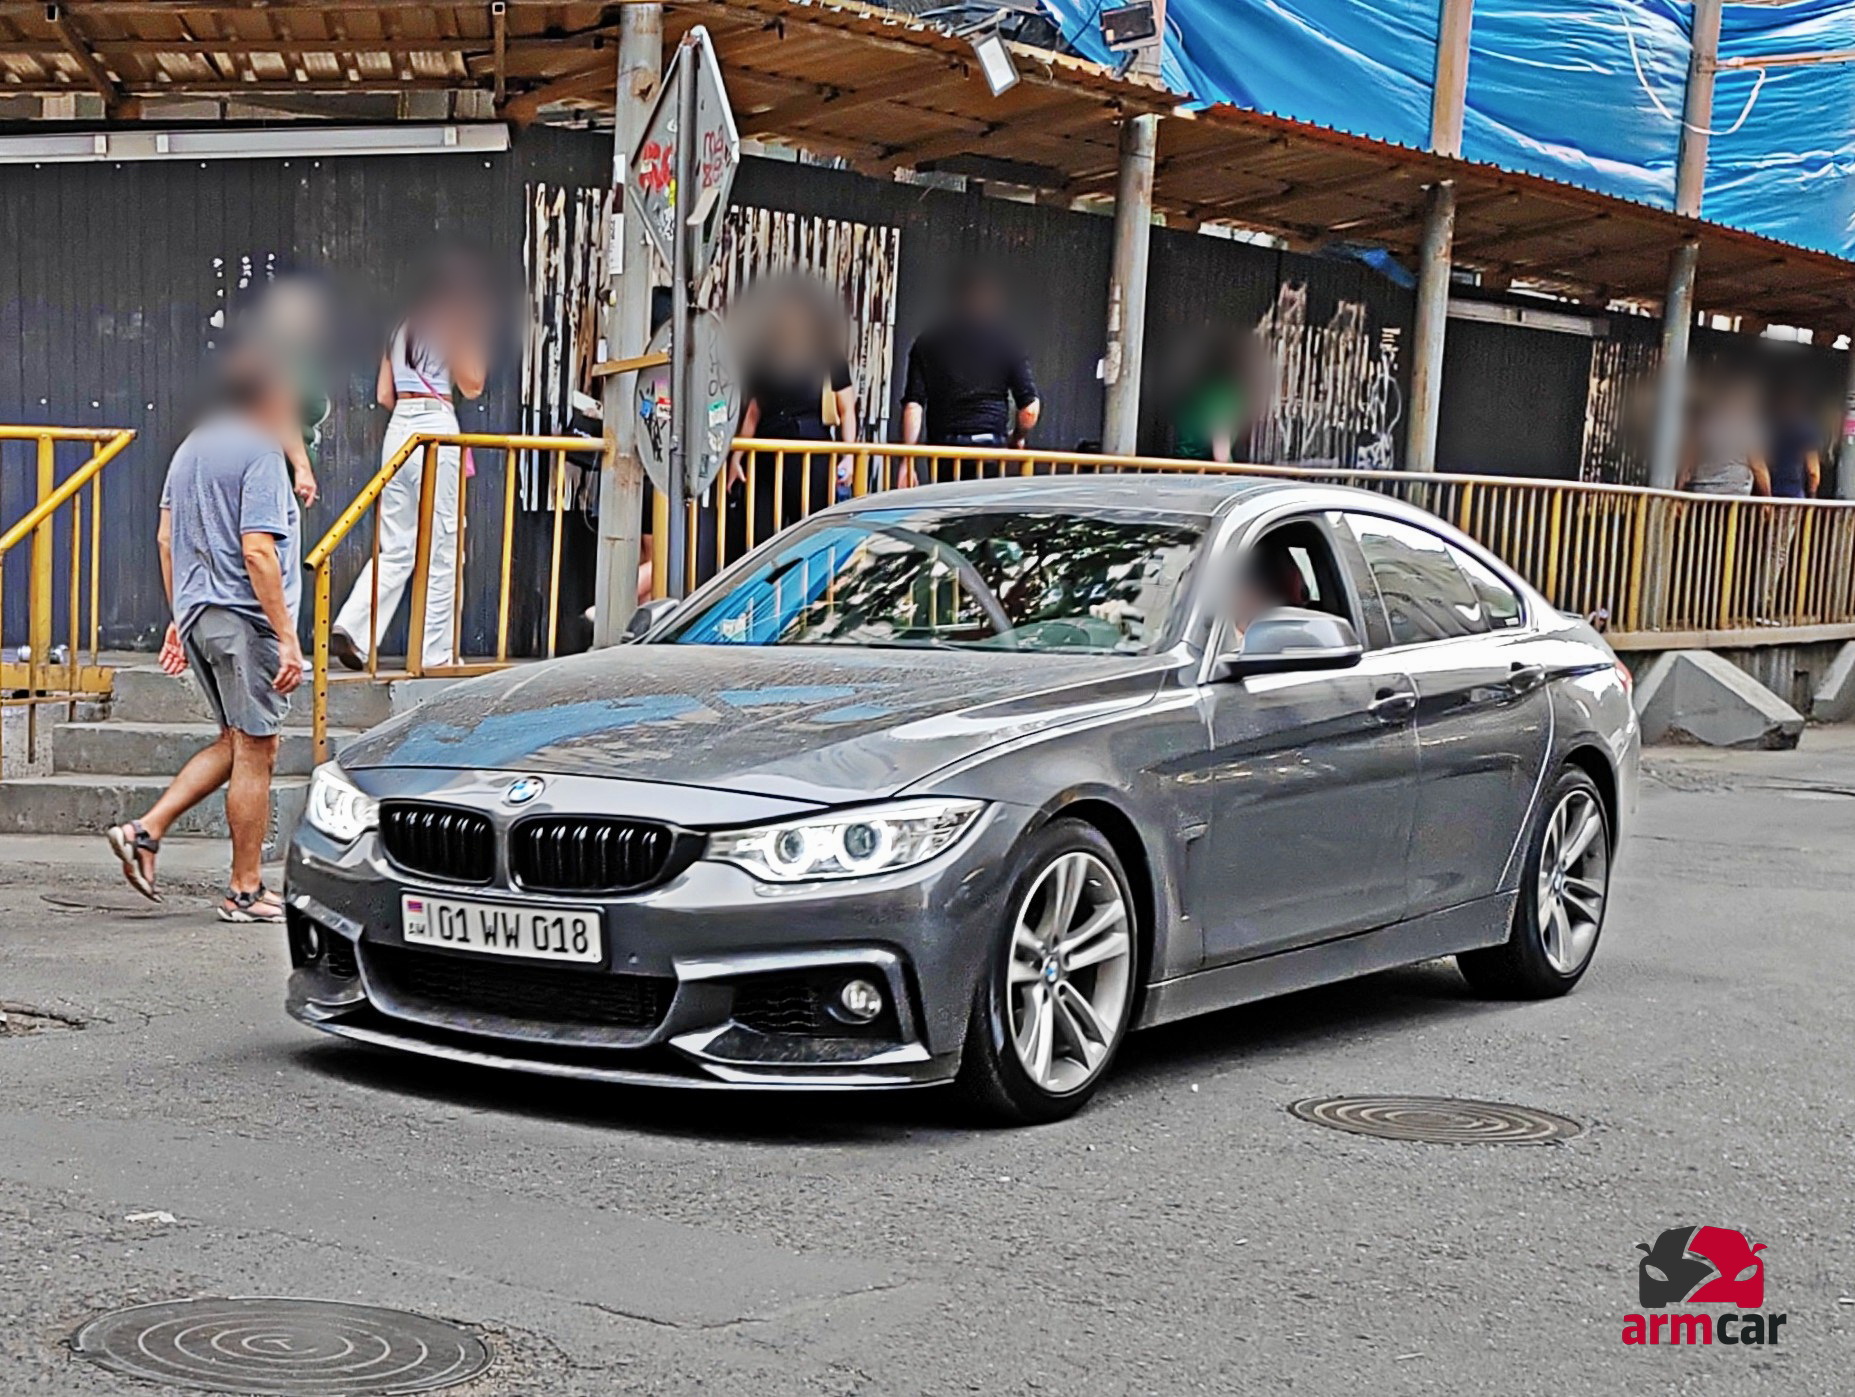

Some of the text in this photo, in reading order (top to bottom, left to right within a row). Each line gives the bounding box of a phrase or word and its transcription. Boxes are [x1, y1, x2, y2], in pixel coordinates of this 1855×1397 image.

[438, 905, 588, 954] 01 WW 018
